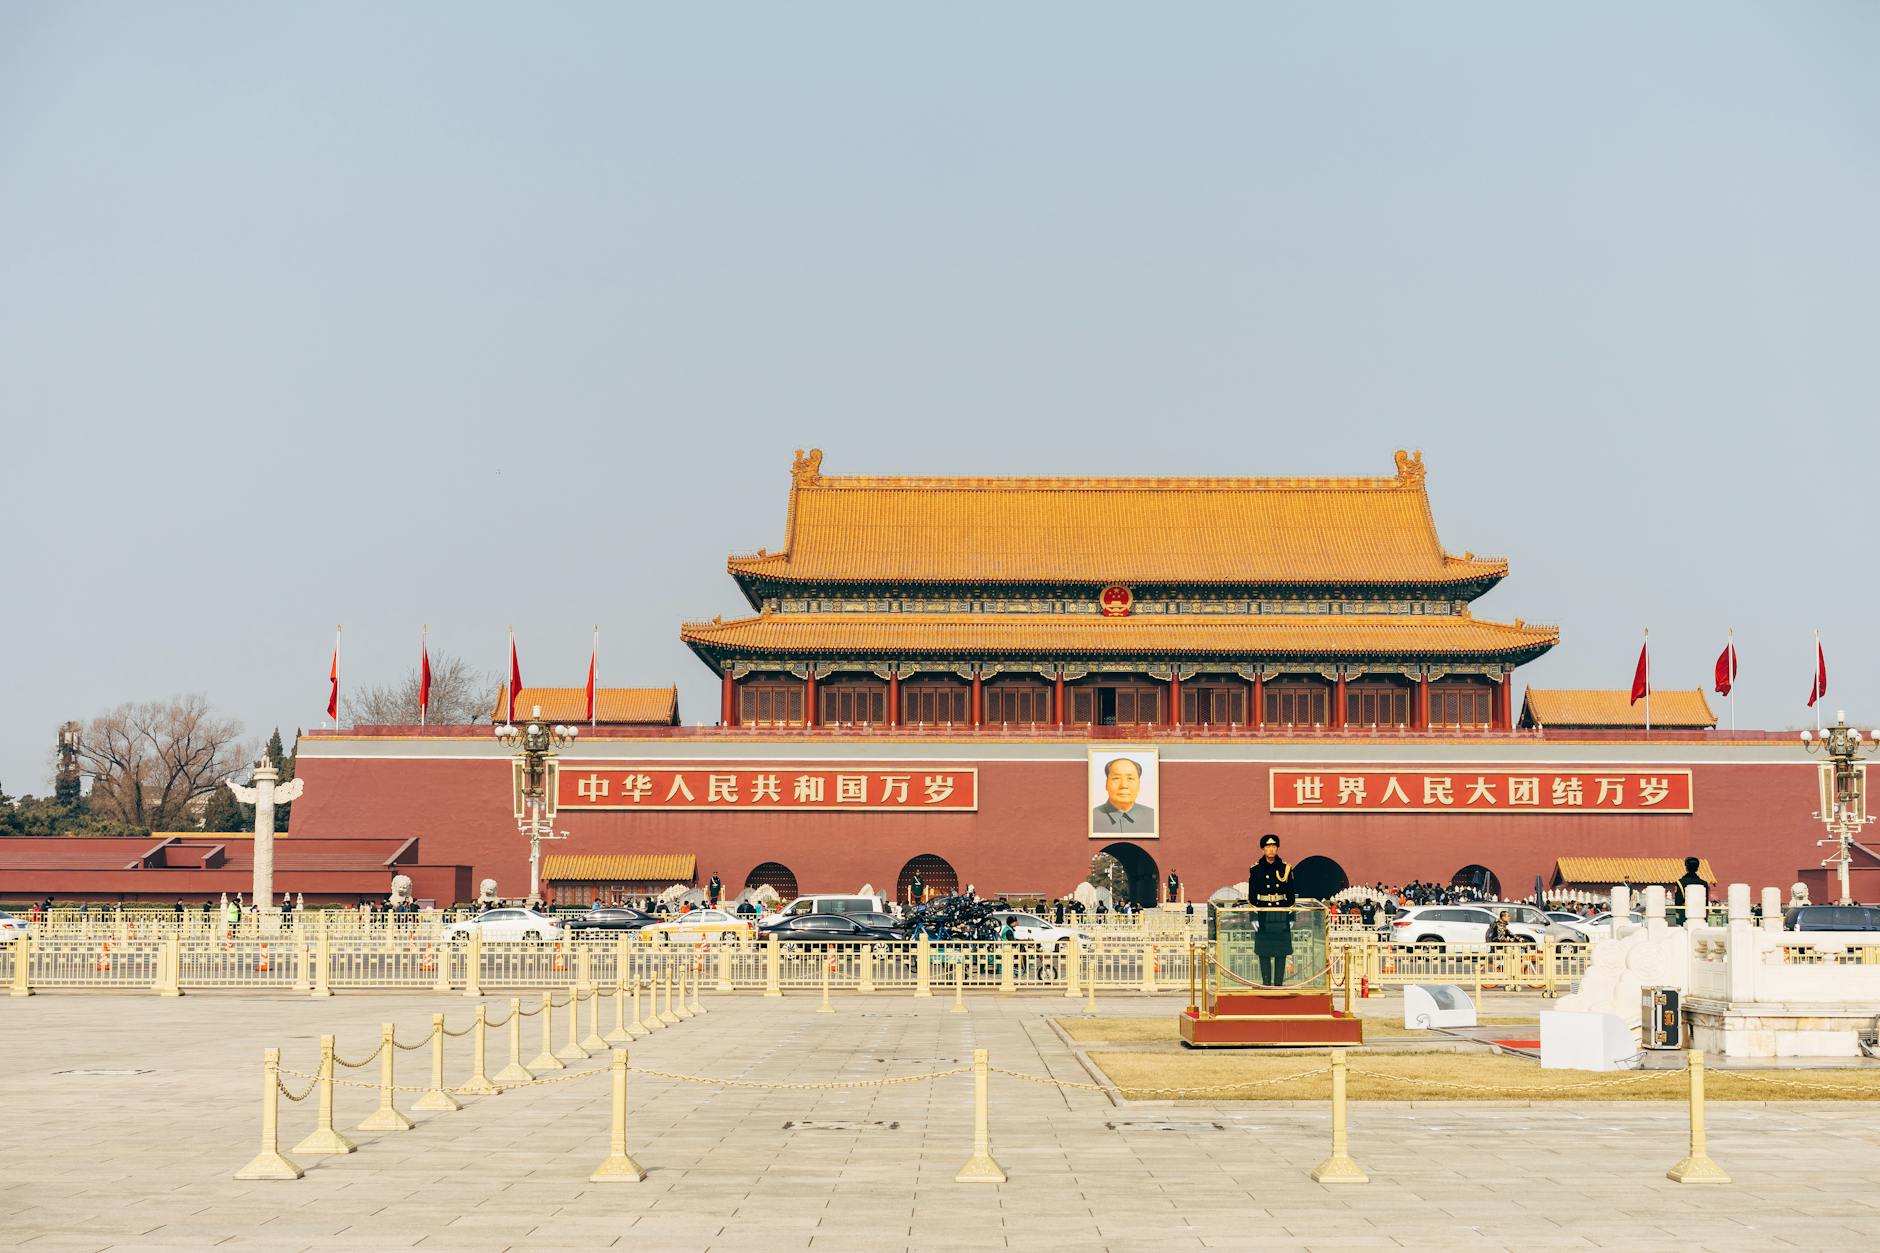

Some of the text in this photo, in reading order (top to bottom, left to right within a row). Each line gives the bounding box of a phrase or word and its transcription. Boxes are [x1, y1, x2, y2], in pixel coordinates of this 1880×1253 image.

[577, 774, 955, 803] 中华人民共和国万岁
[1293, 776, 1670, 805] 世界人民大团结万岁
